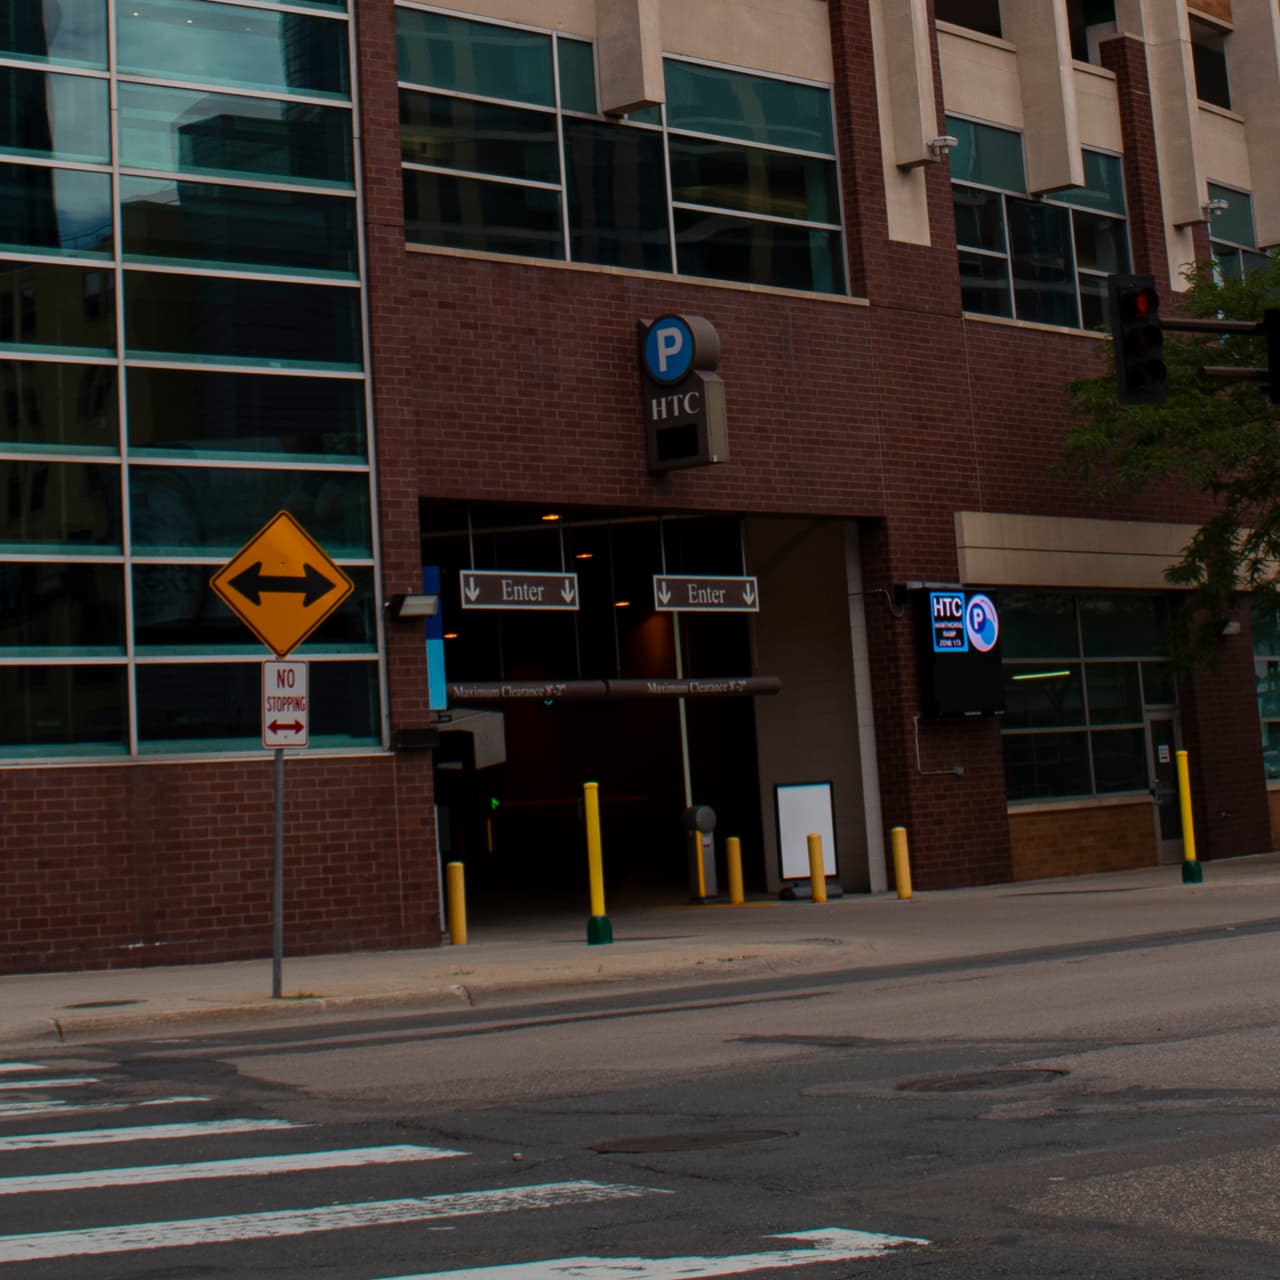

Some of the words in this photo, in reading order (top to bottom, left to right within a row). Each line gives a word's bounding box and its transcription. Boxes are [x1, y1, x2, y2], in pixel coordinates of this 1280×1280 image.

[656, 326, 683, 373] P
[651, 391, 700, 420] HTC
[501, 579, 544, 601] Enter
[687, 583, 726, 604] Enter
[933, 597, 962, 617] HTC
[973, 607, 984, 631] P
[277, 668, 295, 688] NO
[689, 681, 728, 694] Clearance
[453, 685, 499, 698] Maximum
[501, 685, 544, 697] Clearance
[266, 695, 306, 712] STOPPING
